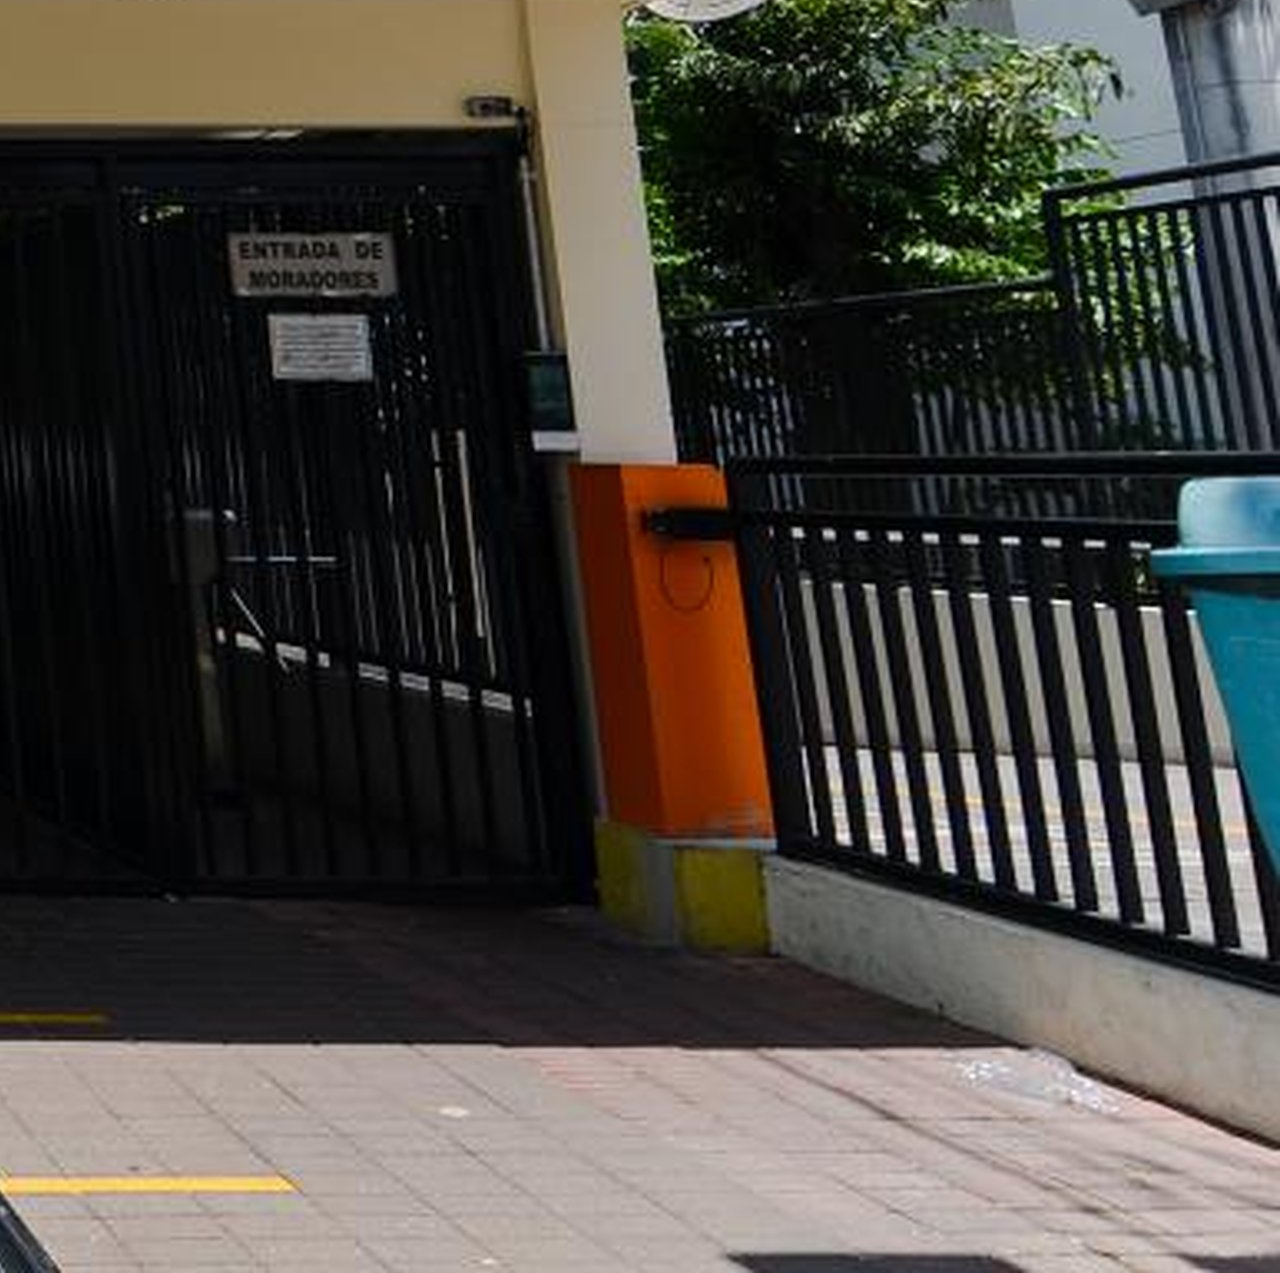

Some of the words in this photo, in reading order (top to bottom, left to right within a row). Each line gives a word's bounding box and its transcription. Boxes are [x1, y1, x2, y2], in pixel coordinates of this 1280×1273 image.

[239, 241, 340, 260] ENTRADA
[355, 241, 384, 260] DE
[248, 269, 380, 290] MORADORES
